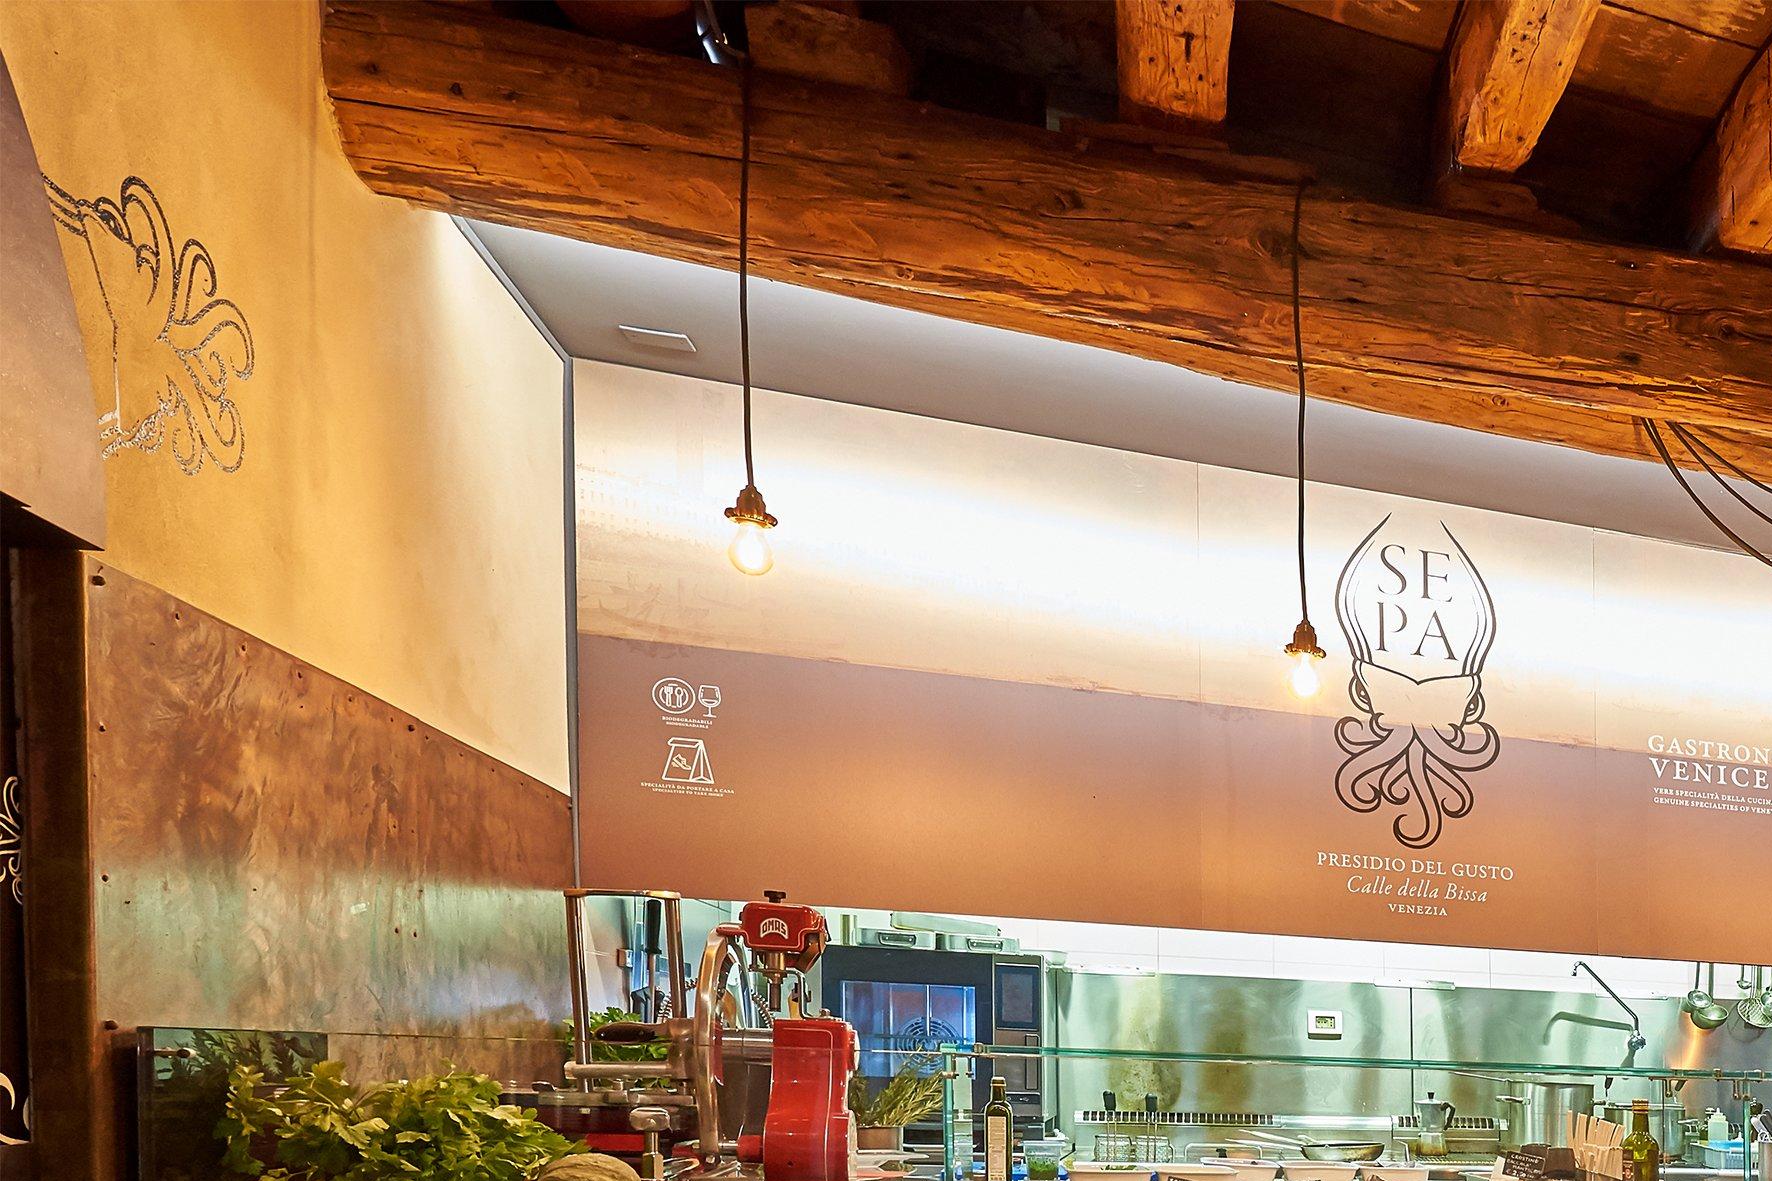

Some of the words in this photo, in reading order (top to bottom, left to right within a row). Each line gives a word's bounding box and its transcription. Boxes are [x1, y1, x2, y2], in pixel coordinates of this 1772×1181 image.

[1377, 543, 1453, 602] SE
[1375, 602, 1456, 661] PA
[1648, 757, 1769, 790] VENICE
[1653, 787, 1674, 796] VERE
[1675, 789, 1720, 800] SPECIALITÀ
[1721, 794, 1746, 803] DELLA
[1653, 797, 1690, 807] GENUINE
[1690, 801, 1738, 812] SPECIALTIES
[1317, 851, 1406, 872] PRESIDIO
[1411, 860, 1447, 875] DEL
[1451, 863, 1514, 881] GUSTO
[1347, 875, 1393, 895] Calle
[1397, 878, 1439, 899] della
[1444, 883, 1488, 902] Bissa
[1388, 903, 1448, 917] VENEZIA
[762, 919, 787, 936] OMAS
